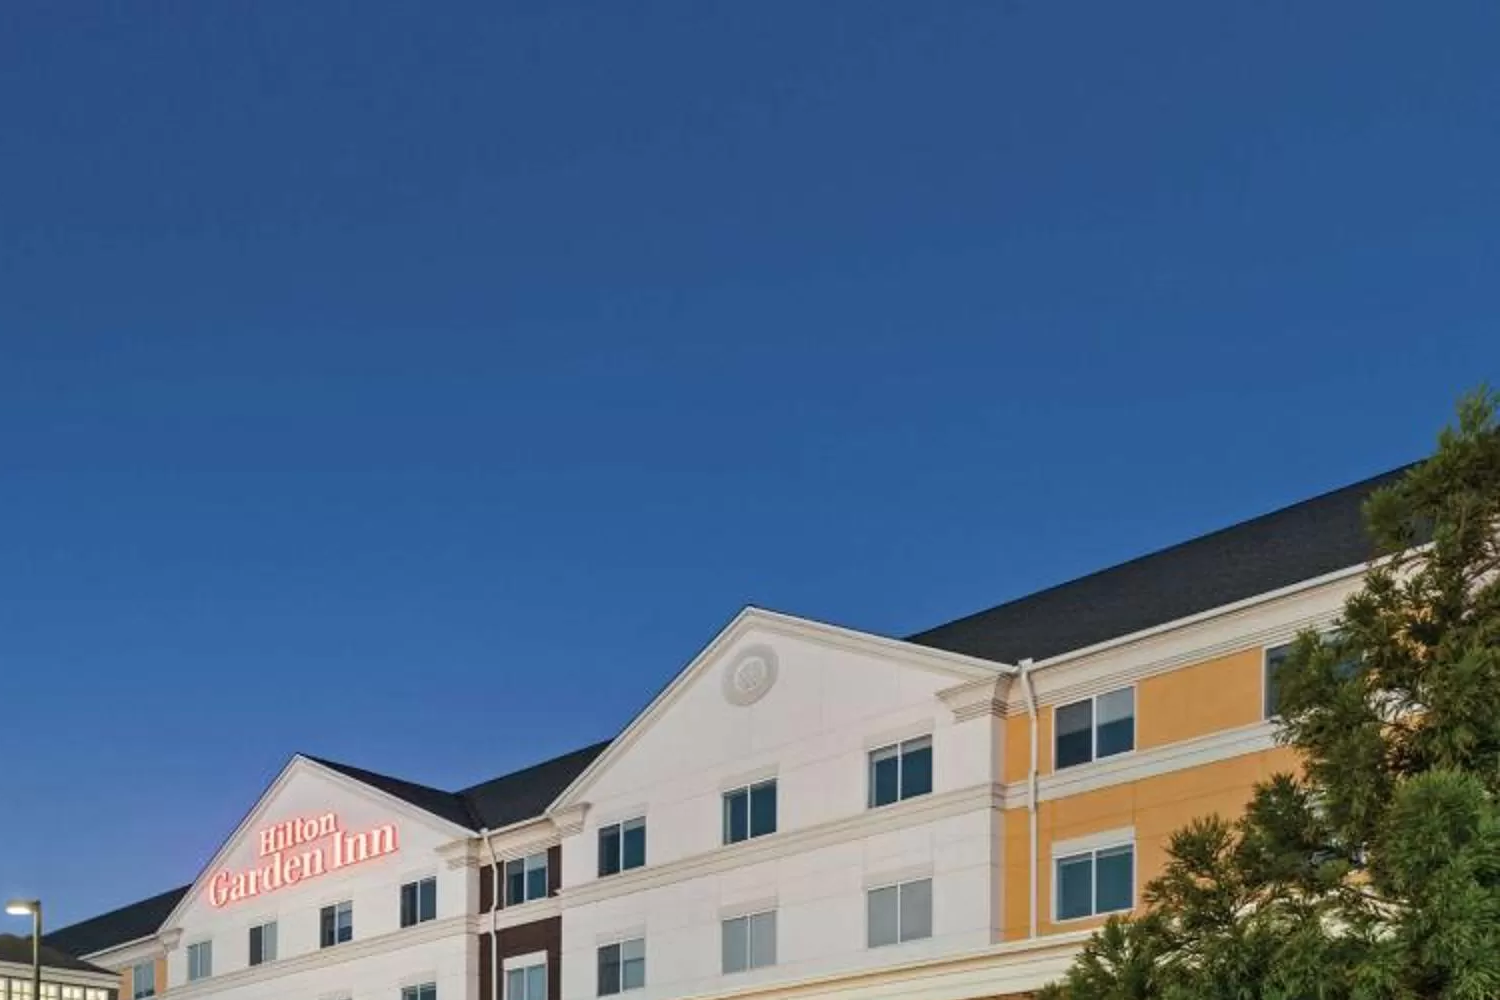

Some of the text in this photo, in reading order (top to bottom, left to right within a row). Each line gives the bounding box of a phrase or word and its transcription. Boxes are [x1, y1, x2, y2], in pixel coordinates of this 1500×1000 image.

[260, 813, 336, 856] Hilton
[209, 825, 397, 907] Garden Inn
